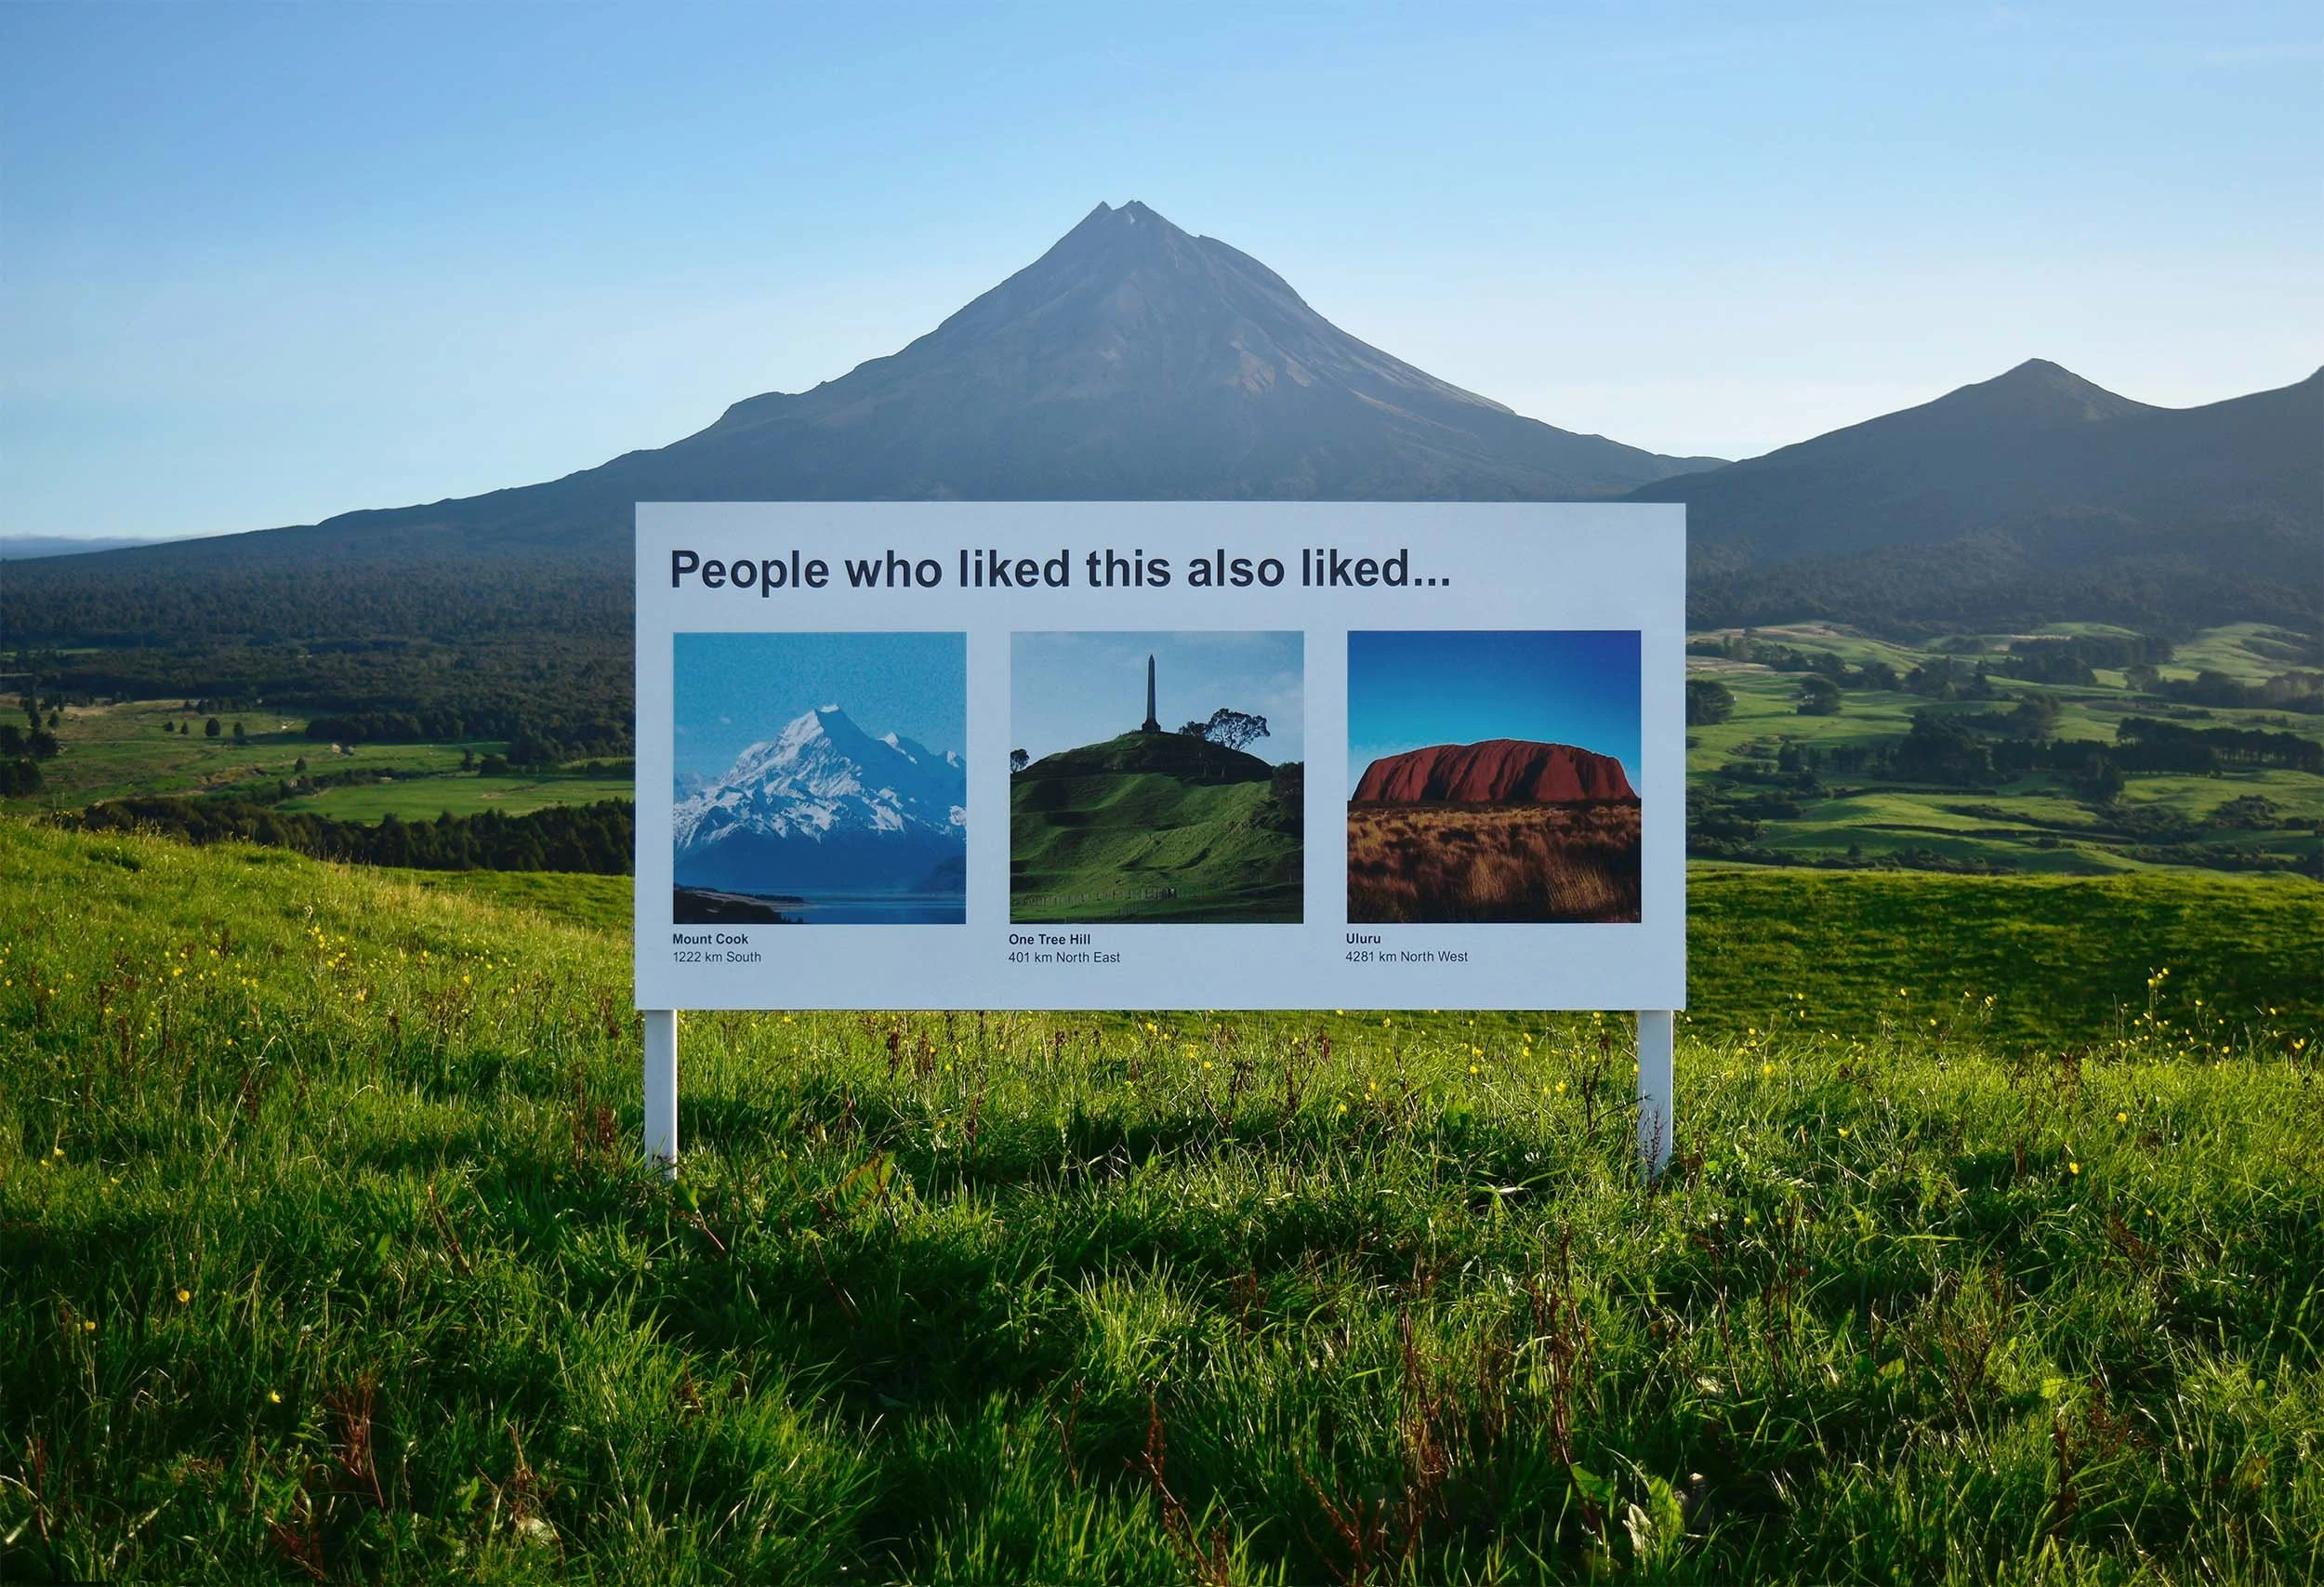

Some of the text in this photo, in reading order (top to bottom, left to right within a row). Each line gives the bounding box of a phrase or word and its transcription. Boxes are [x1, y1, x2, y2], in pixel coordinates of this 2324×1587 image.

[672, 549, 1449, 598] People who liked this also liked...
[673, 933, 748, 945] Mount Cook
[1009, 933, 1090, 945] One Tree Hill
[1346, 933, 1380, 944] Uluru
[674, 951, 761, 962] 1222 km South
[1009, 952, 1120, 963] 401 km North East
[1346, 951, 1468, 962] 4281 km North West
